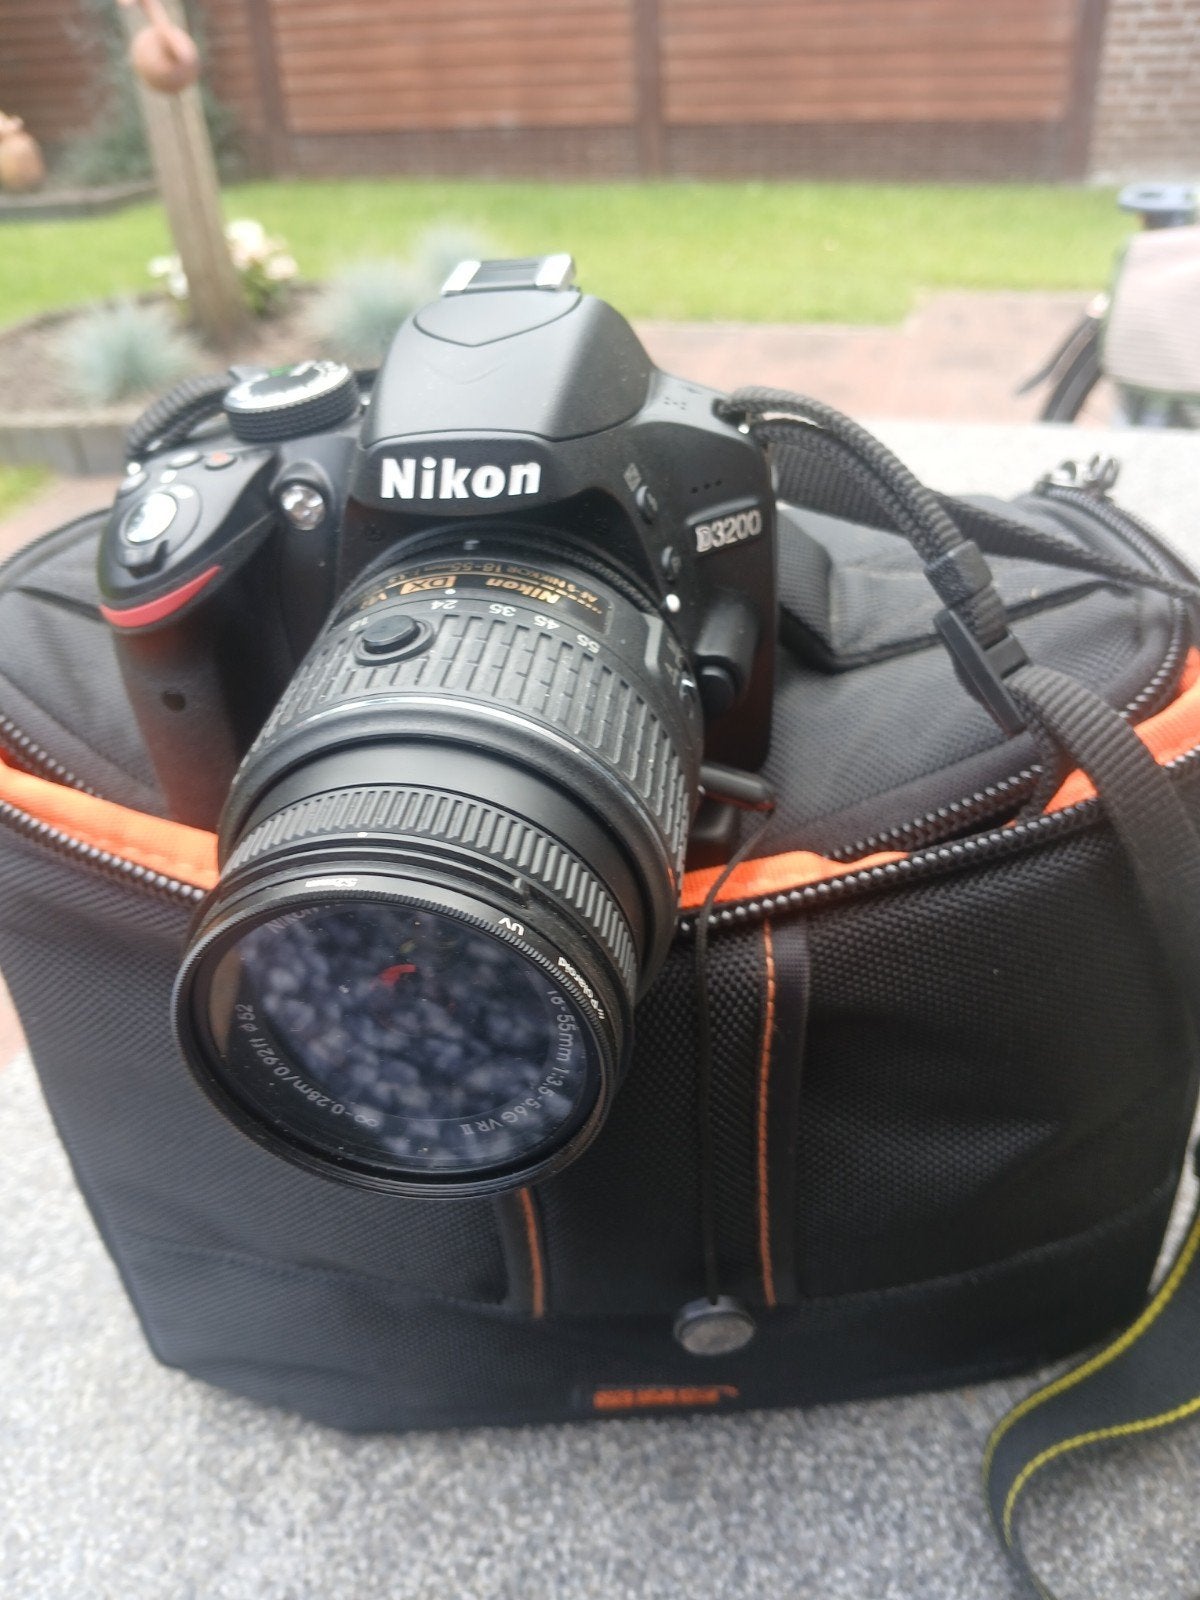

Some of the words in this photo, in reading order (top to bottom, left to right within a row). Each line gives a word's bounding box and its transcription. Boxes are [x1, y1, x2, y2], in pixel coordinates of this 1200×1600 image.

[380, 456, 542, 500] Nikon
[695, 509, 762, 553] D3200
[404, 576, 456, 594] DX
[485, 578, 560, 604] Nikon
[430, 599, 459, 610] 24
[489, 603, 518, 617] 35
[532, 615, 560, 630] 45
[576, 634, 601, 654] 55
[498, 917, 525, 936] UV
[474, 1118, 504, 1133] VR
